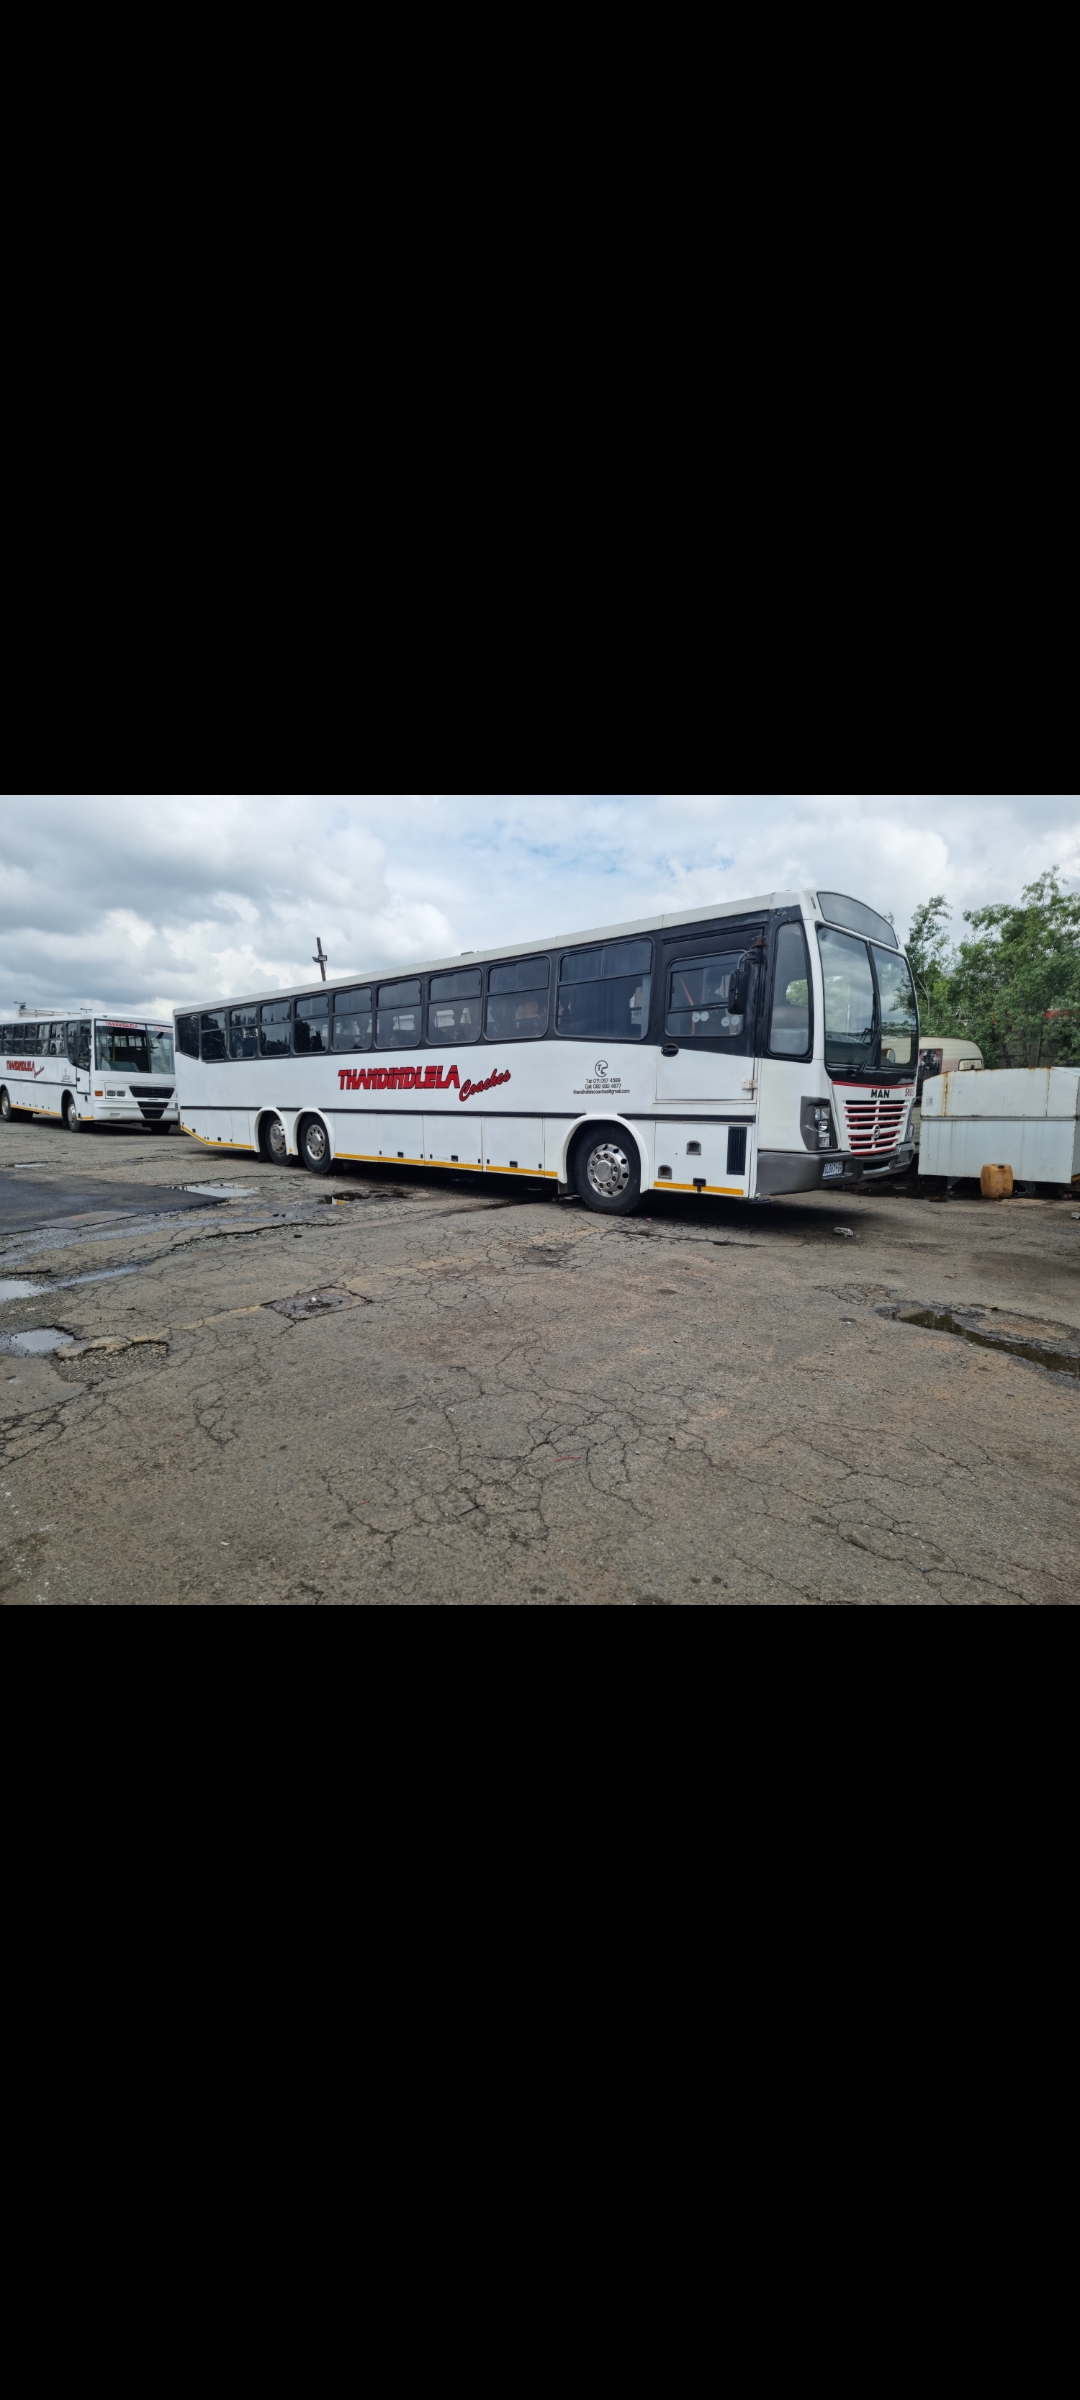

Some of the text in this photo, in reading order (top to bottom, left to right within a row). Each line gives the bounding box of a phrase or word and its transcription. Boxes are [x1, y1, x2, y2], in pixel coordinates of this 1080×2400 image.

[338, 1065, 511, 1102] THANDINDLELA Coaches
[870, 1089, 890, 1098] MAN
